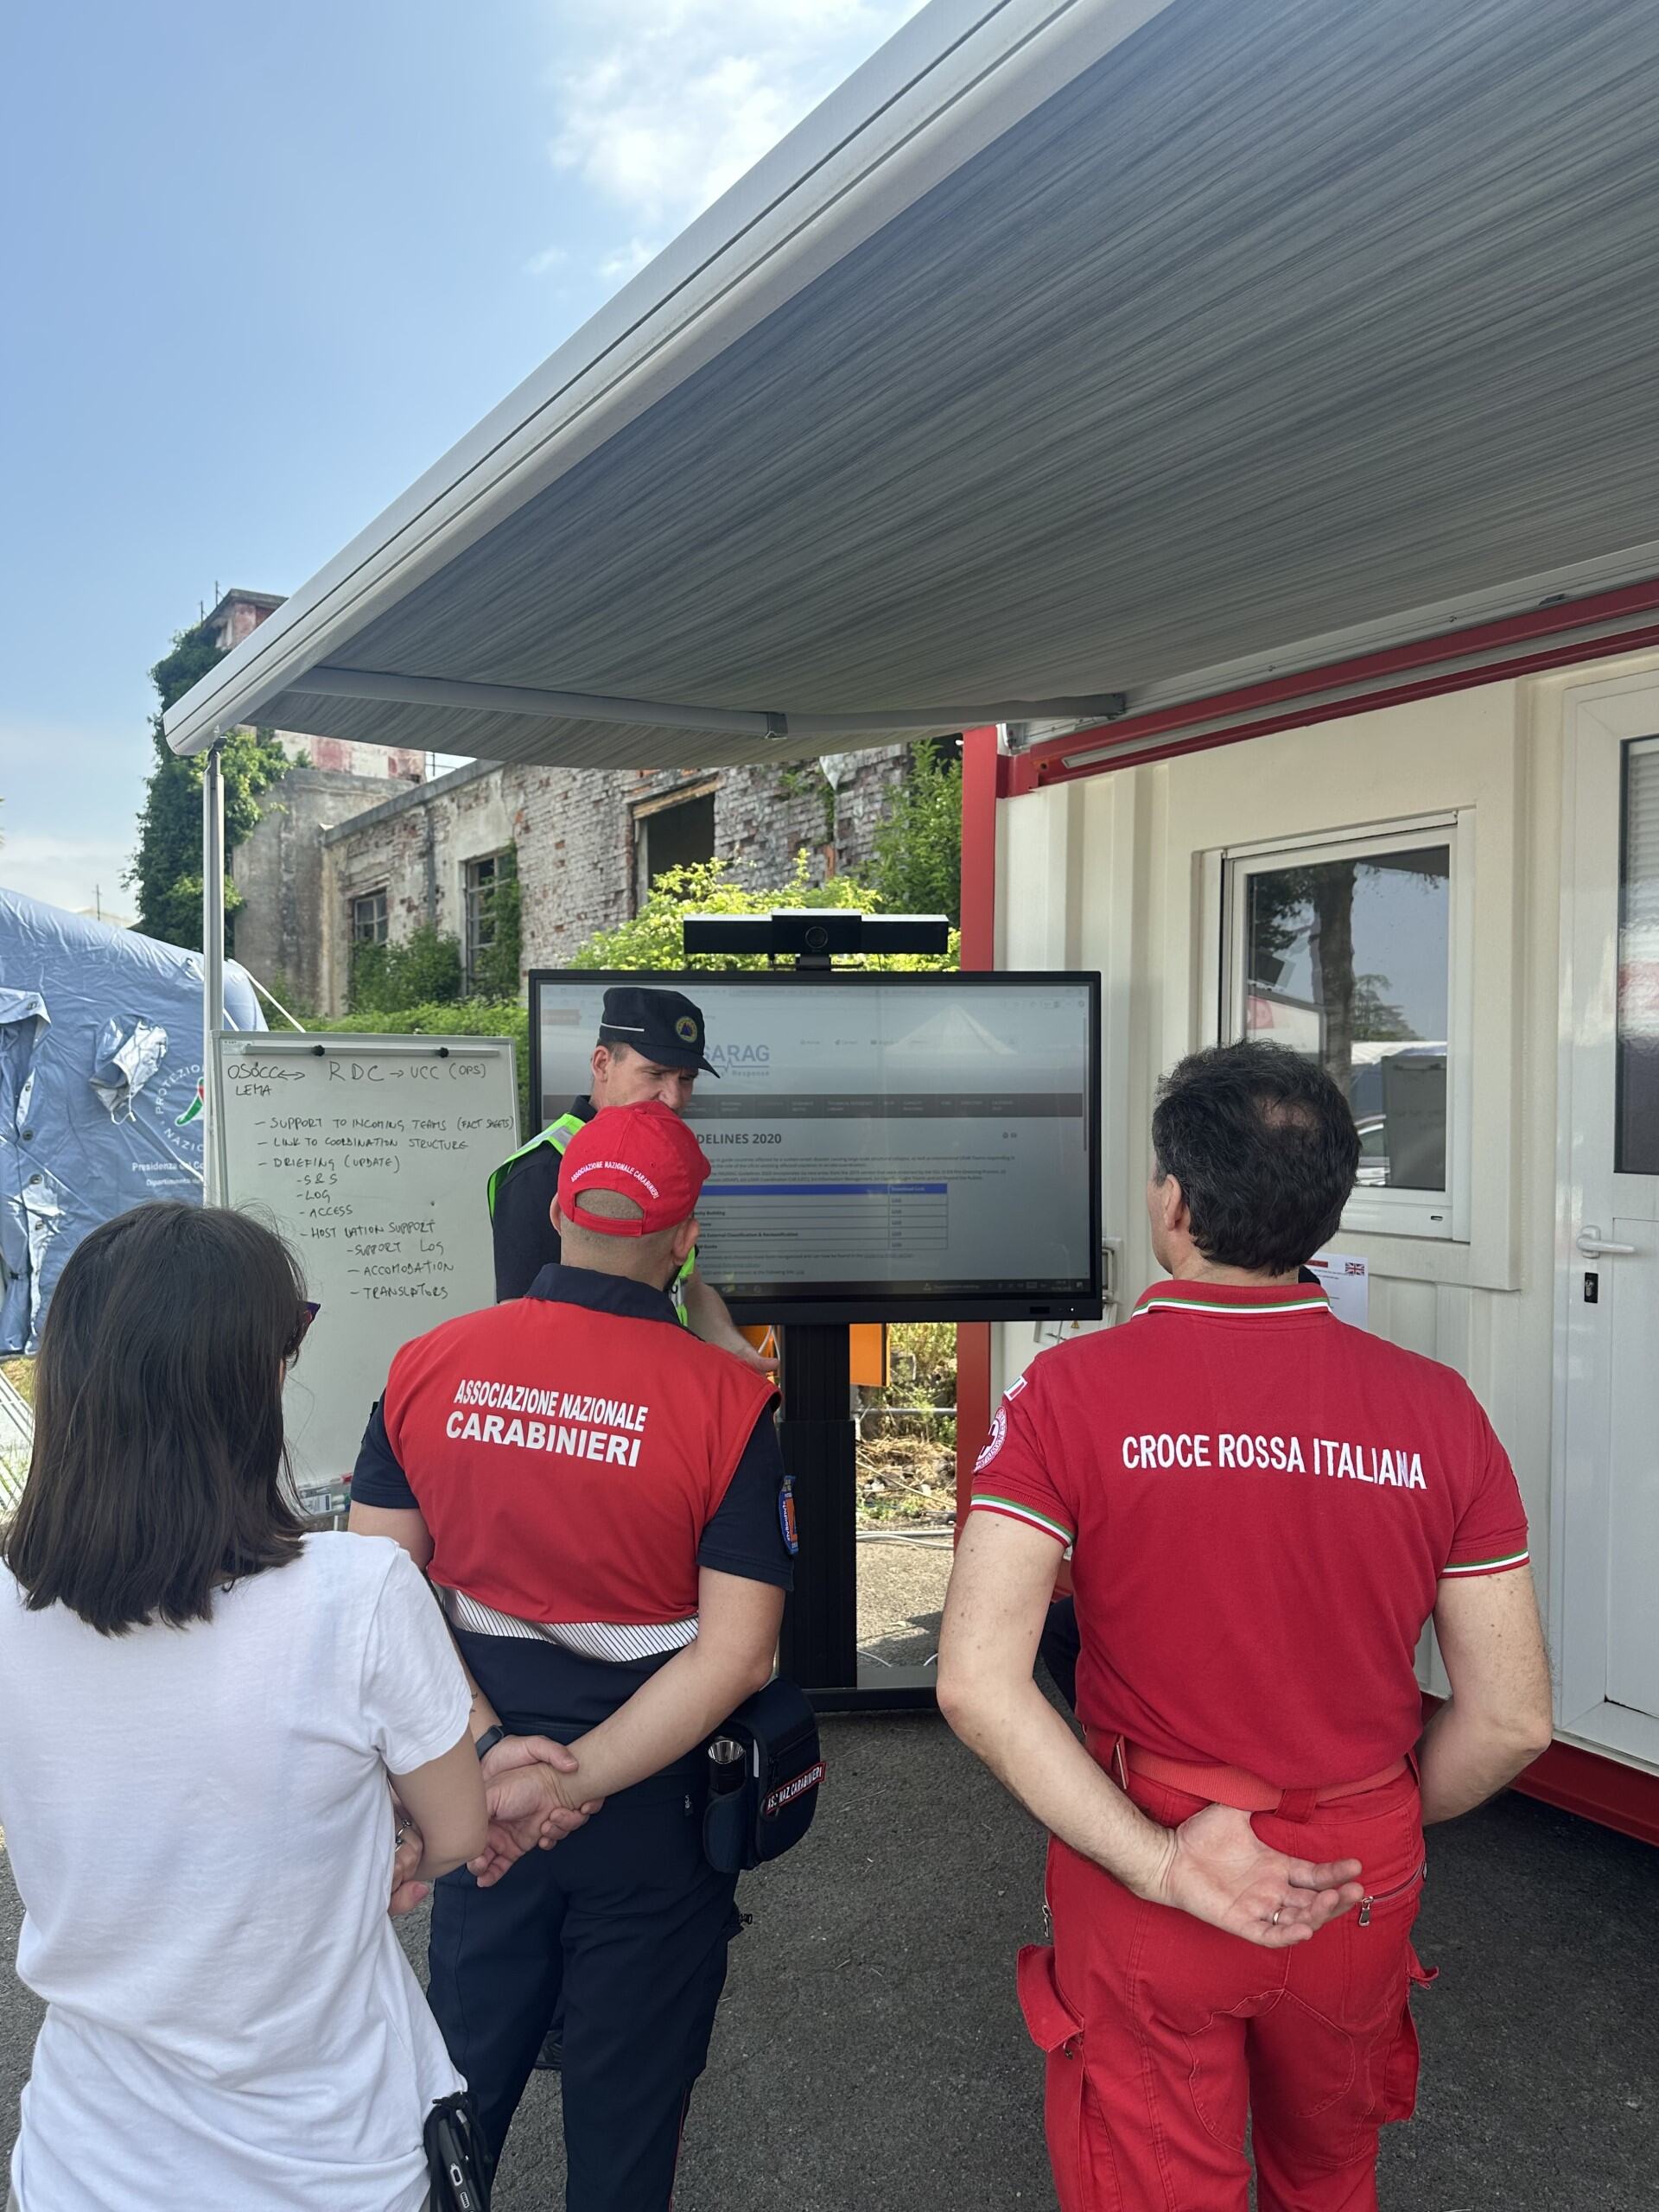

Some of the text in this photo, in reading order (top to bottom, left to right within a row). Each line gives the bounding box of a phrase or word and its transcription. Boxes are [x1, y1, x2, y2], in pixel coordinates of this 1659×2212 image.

[156, 1064, 204, 1115] PROTEZIO
[270, 1117, 322, 1129] SUPPORT
[332, 1119, 347, 1128] TO
[353, 1119, 404, 1132] INCOMING
[411, 1120, 447, 1131] TEAMS
[274, 1137, 301, 1147] LINK
[409, 1138, 469, 1150] STRUCTURE
[753, 1134, 782, 1144] 2020
[344, 1154, 400, 1173] (UPDATE)
[570, 1160, 660, 1199] ASSOCIAZIONE NAZIONALE CARABINIERI
[305, 1189, 331, 1203] LOG
[309, 1205, 353, 1218] ACCESS
[311, 1226, 336, 1238] HOST
[389, 1221, 436, 1234] SUPPORT
[355, 1239, 445, 1256] SUPPORT LOG
[364, 1260, 454, 1276] ACCOMODATION
[363, 1283, 449, 1300] TRANSLATORS
[454, 1379, 649, 1433] ASSOCIAZIONE NAZIONALE
[446, 1410, 642, 1467] CARABINIERI
[1122, 1433, 1428, 1490] CROCE ROSSA ITALIANA
